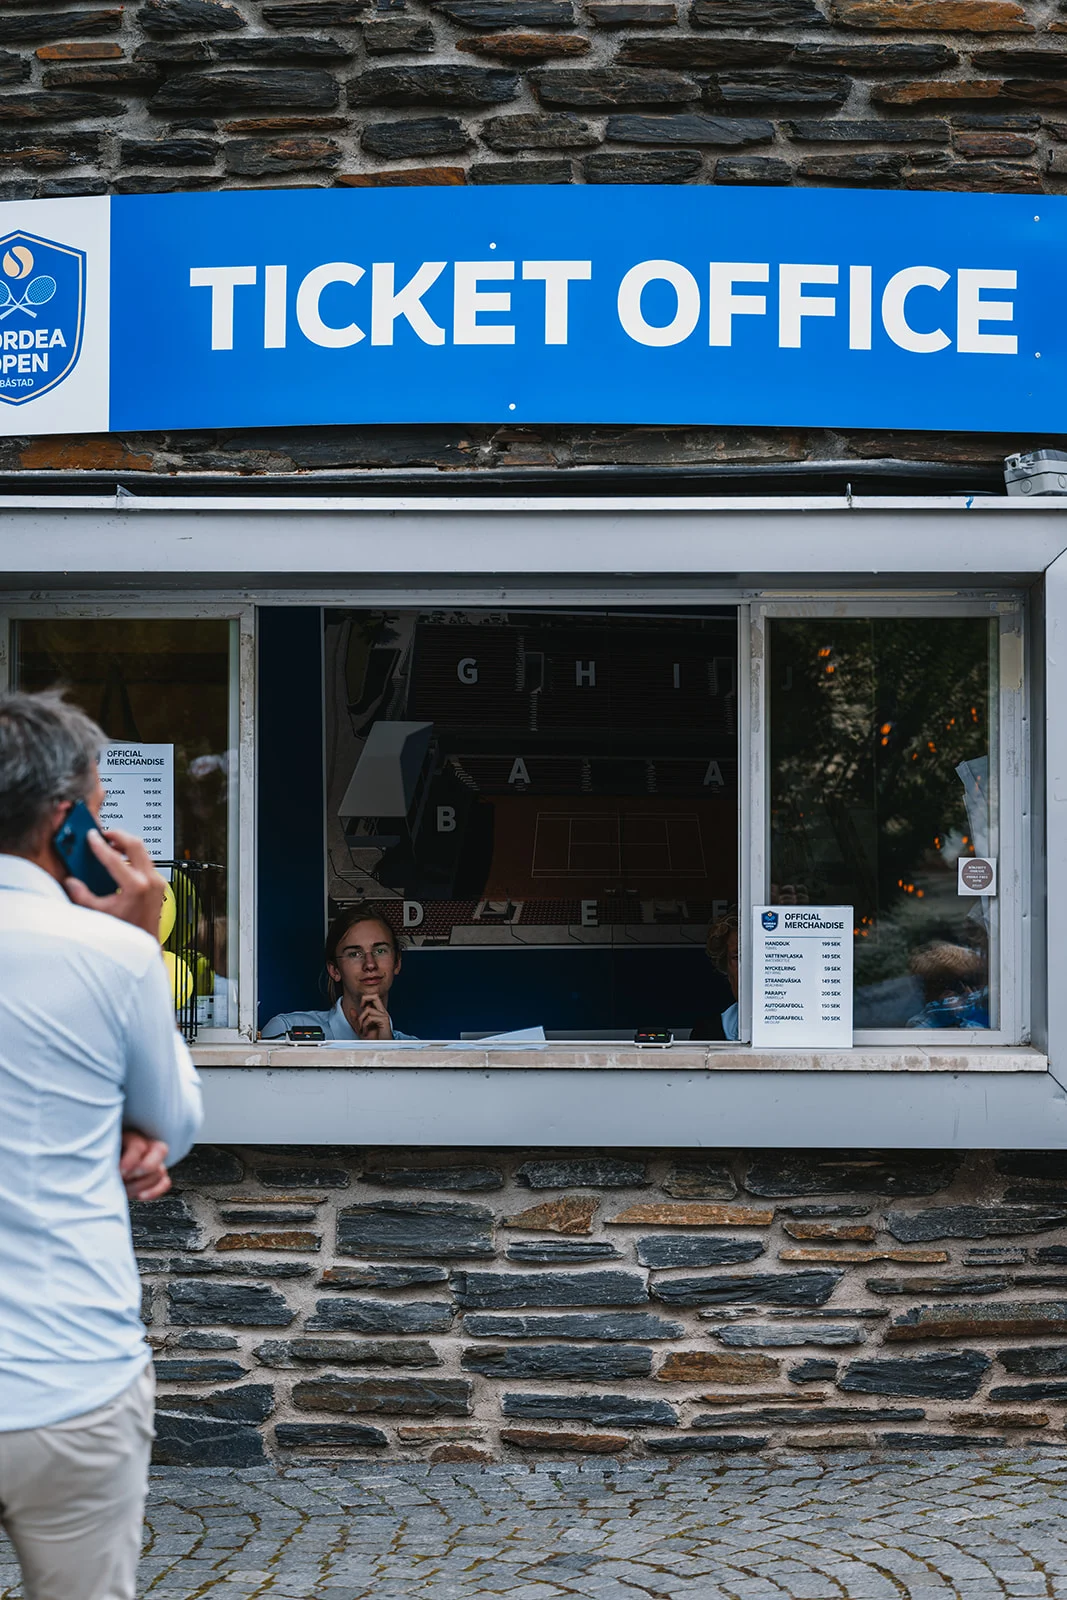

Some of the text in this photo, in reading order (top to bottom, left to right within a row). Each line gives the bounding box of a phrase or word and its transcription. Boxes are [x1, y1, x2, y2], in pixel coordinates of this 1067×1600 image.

[190, 259, 1018, 354] TICKET OFFICE
[0, 328, 67, 350] RDEA
[0, 352, 48, 374] PEN
[457, 657, 478, 685] G
[575, 660, 596, 687] H
[107, 750, 142, 758] OFFICIAL
[107, 758, 165, 766] MERCHANDISE
[508, 757, 531, 785] A
[703, 760, 725, 786] A
[437, 806, 456, 832] B
[403, 900, 424, 928] D
[581, 900, 598, 927] E
[785, 913, 821, 921] OFFICIAL
[785, 921, 844, 929] MERCHANDISE
